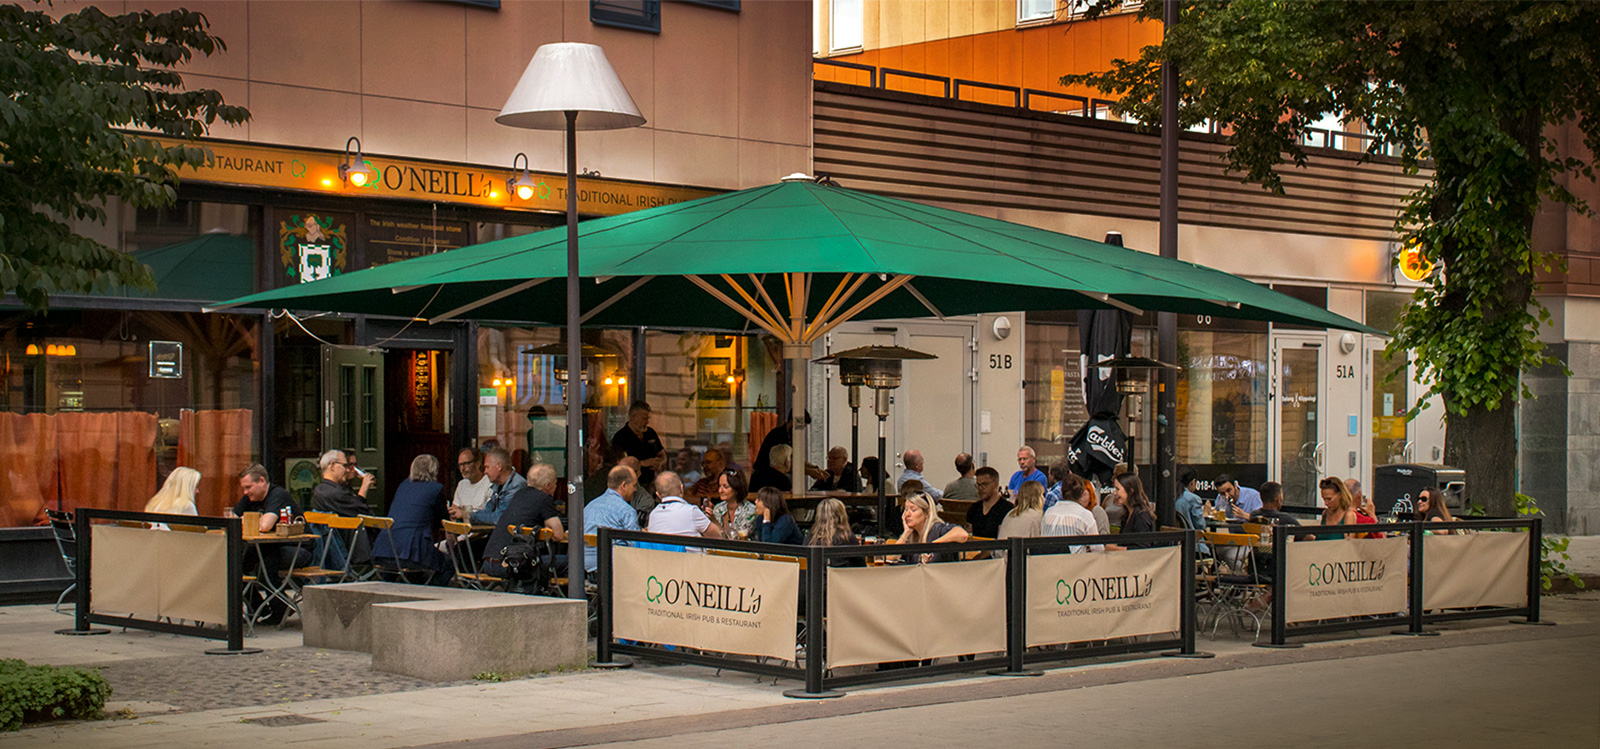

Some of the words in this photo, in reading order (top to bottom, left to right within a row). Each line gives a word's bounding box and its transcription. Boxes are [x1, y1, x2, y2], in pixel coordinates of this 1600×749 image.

[201, 155, 284, 174] TAURANT
[557, 187, 633, 206] TDITIONAL
[636, 195, 664, 208] IRISH
[1087, 425, 1124, 463] Carlsber
[647, 608, 684, 619] TRADITIONAL
[686, 613, 700, 621] IRISH
[702, 615, 715, 623] PUB
[721, 617, 762, 628] RESTAURANT
[1057, 608, 1090, 617] TRADITIONAL
[1122, 602, 1152, 611] RESTAURANT
